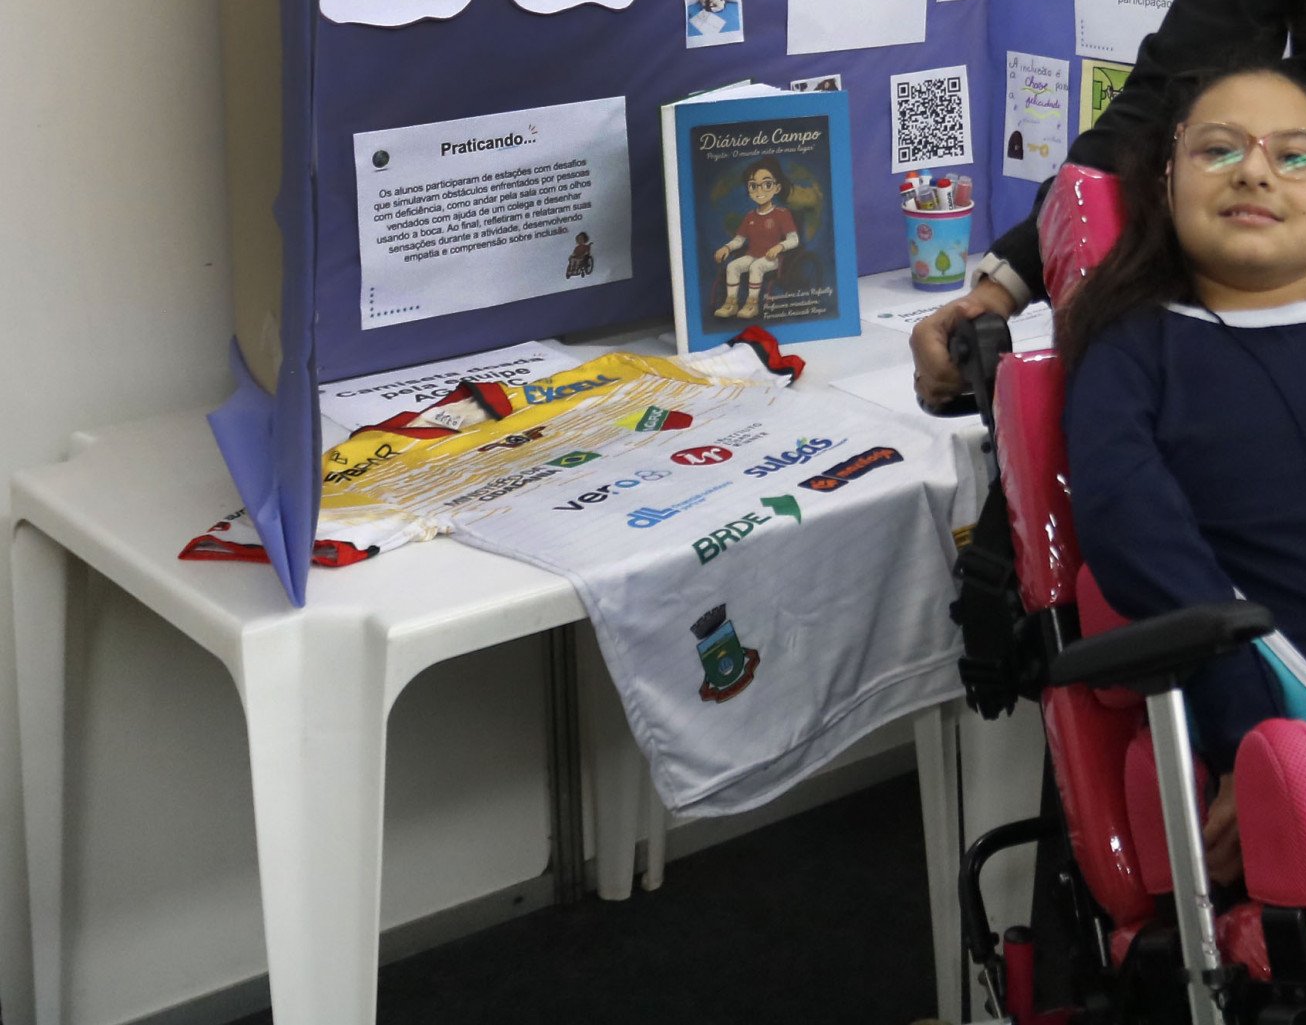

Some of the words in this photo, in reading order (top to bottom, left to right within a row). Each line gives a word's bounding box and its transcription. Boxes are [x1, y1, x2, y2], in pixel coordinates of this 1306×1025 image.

[440, 133, 536, 156] Praticando...
[699, 131, 751, 151] Diário
[752, 130, 768, 146] de
[771, 127, 822, 145] Campo
[379, 189, 393, 199] Os
[394, 185, 424, 196] alunos
[425, 176, 479, 194] participaram
[480, 173, 492, 183] de
[493, 168, 532, 181] estações
[533, 165, 551, 175] com
[336, 370, 457, 398] Camiseta
[381, 383, 438, 400] pela
[692, 511, 772, 566] BRDE
